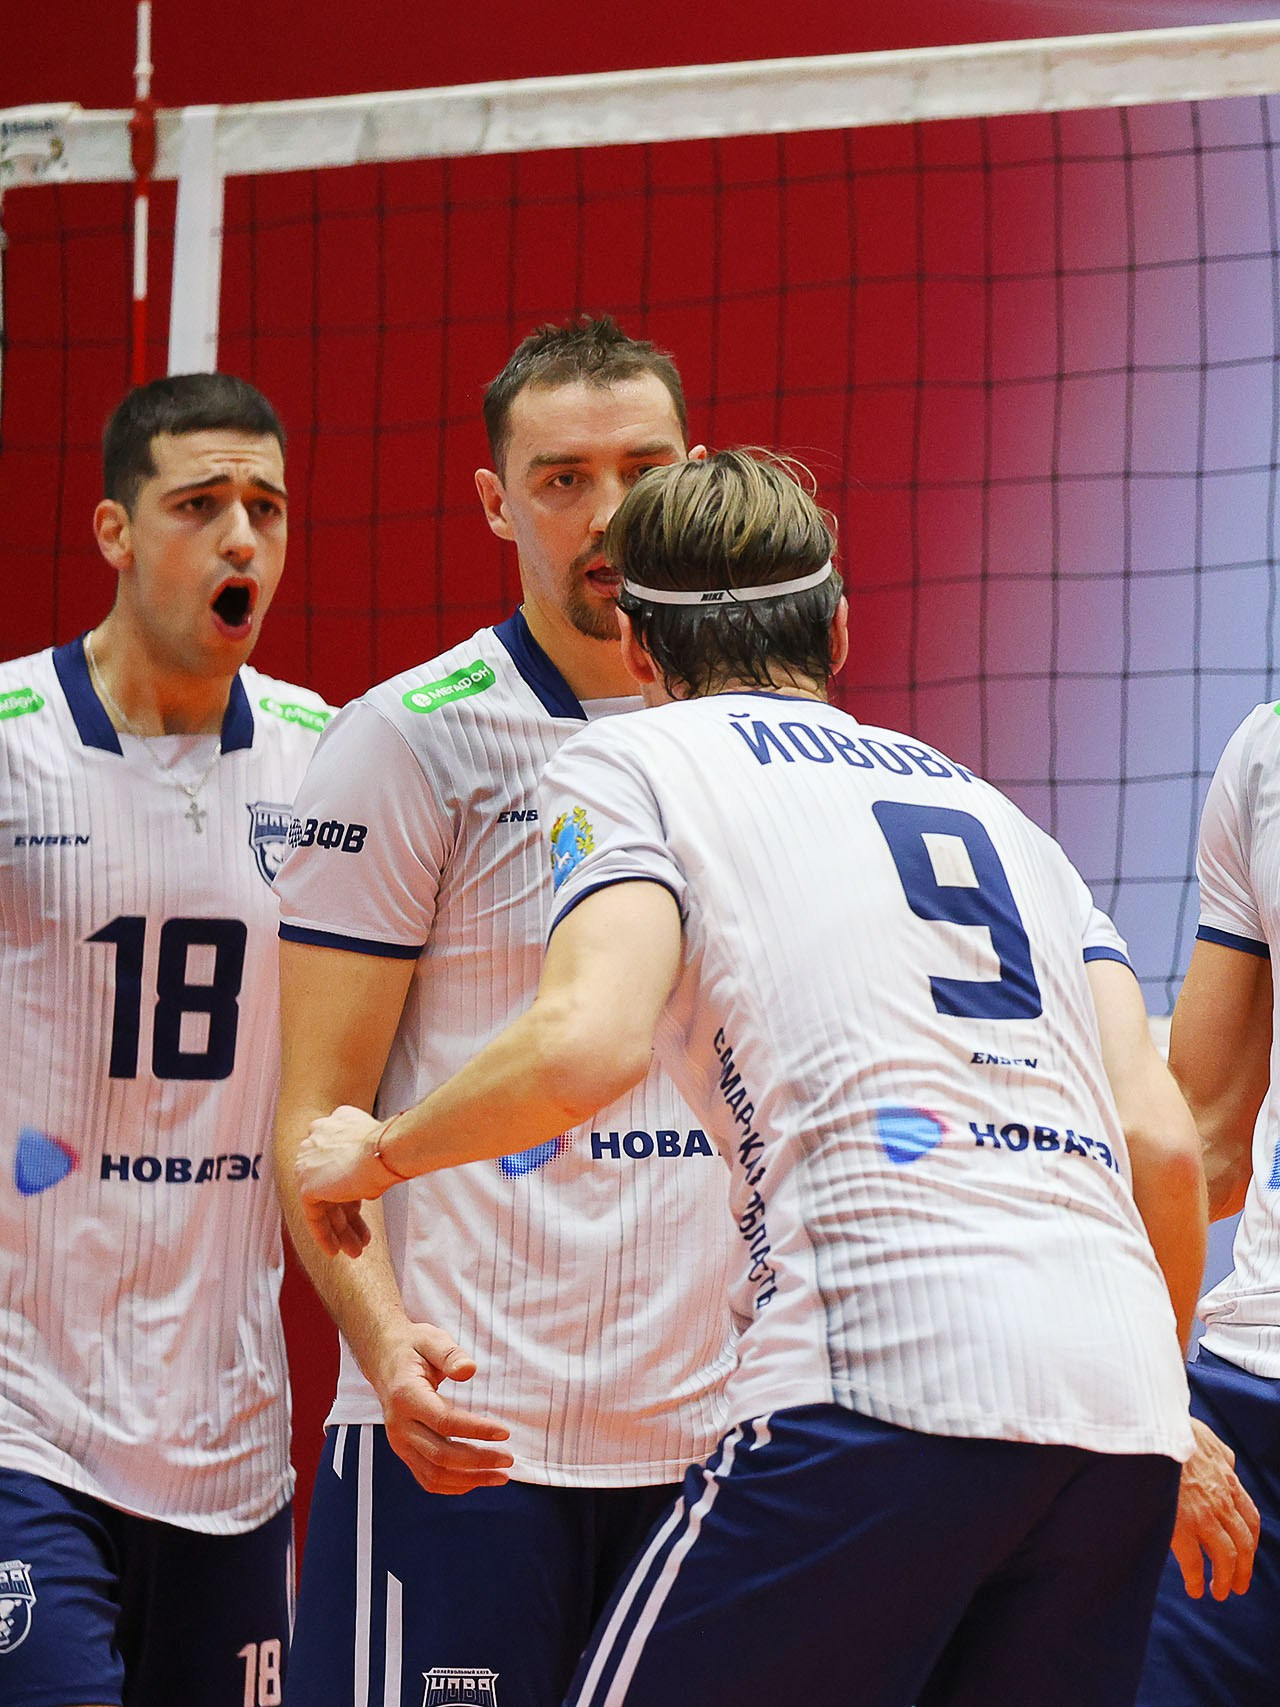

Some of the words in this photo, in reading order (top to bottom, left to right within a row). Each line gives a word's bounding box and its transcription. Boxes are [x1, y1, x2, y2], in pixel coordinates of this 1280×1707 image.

[497, 809, 539, 823] ENS
[14, 834, 90, 848] ENSEN
[872, 800, 1043, 1019] 9
[84, 916, 248, 1080] 18
[591, 1129, 721, 1159] НОВА
[237, 1638, 282, 1707] 18
